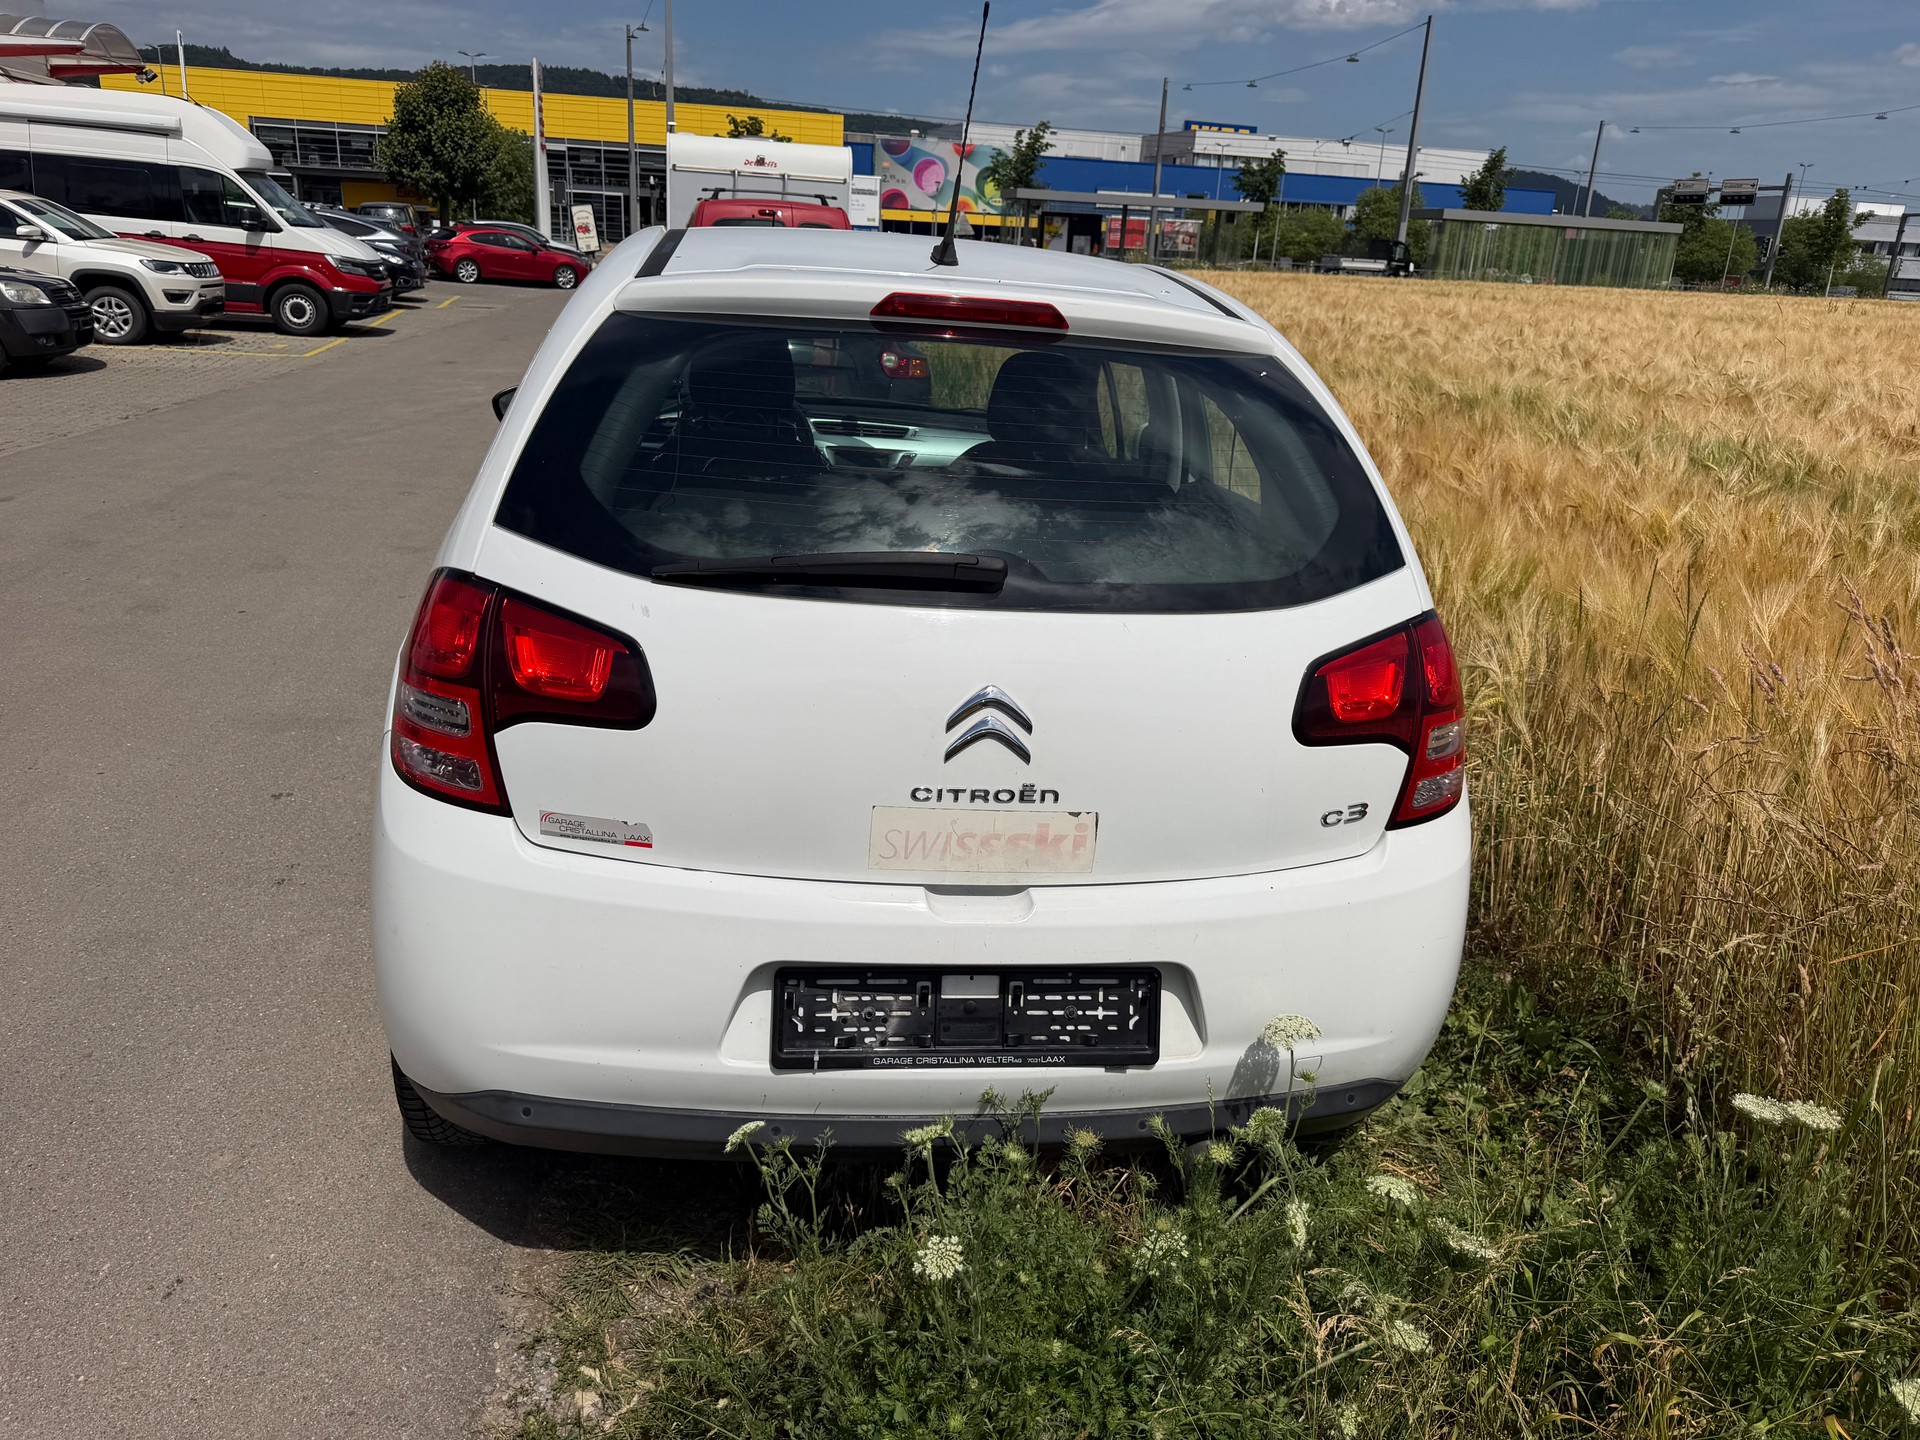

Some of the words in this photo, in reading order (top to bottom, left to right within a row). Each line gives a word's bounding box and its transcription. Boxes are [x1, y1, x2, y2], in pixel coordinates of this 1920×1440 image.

[549, 816, 586, 828] GARAGE
[1320, 803, 1369, 827] C3
[559, 825, 617, 838] CRISTALLINA
[624, 833, 650, 842] LAAX
[873, 1057, 913, 1065] GARAGE
[915, 1056, 975, 1064] CRISTALLINA
